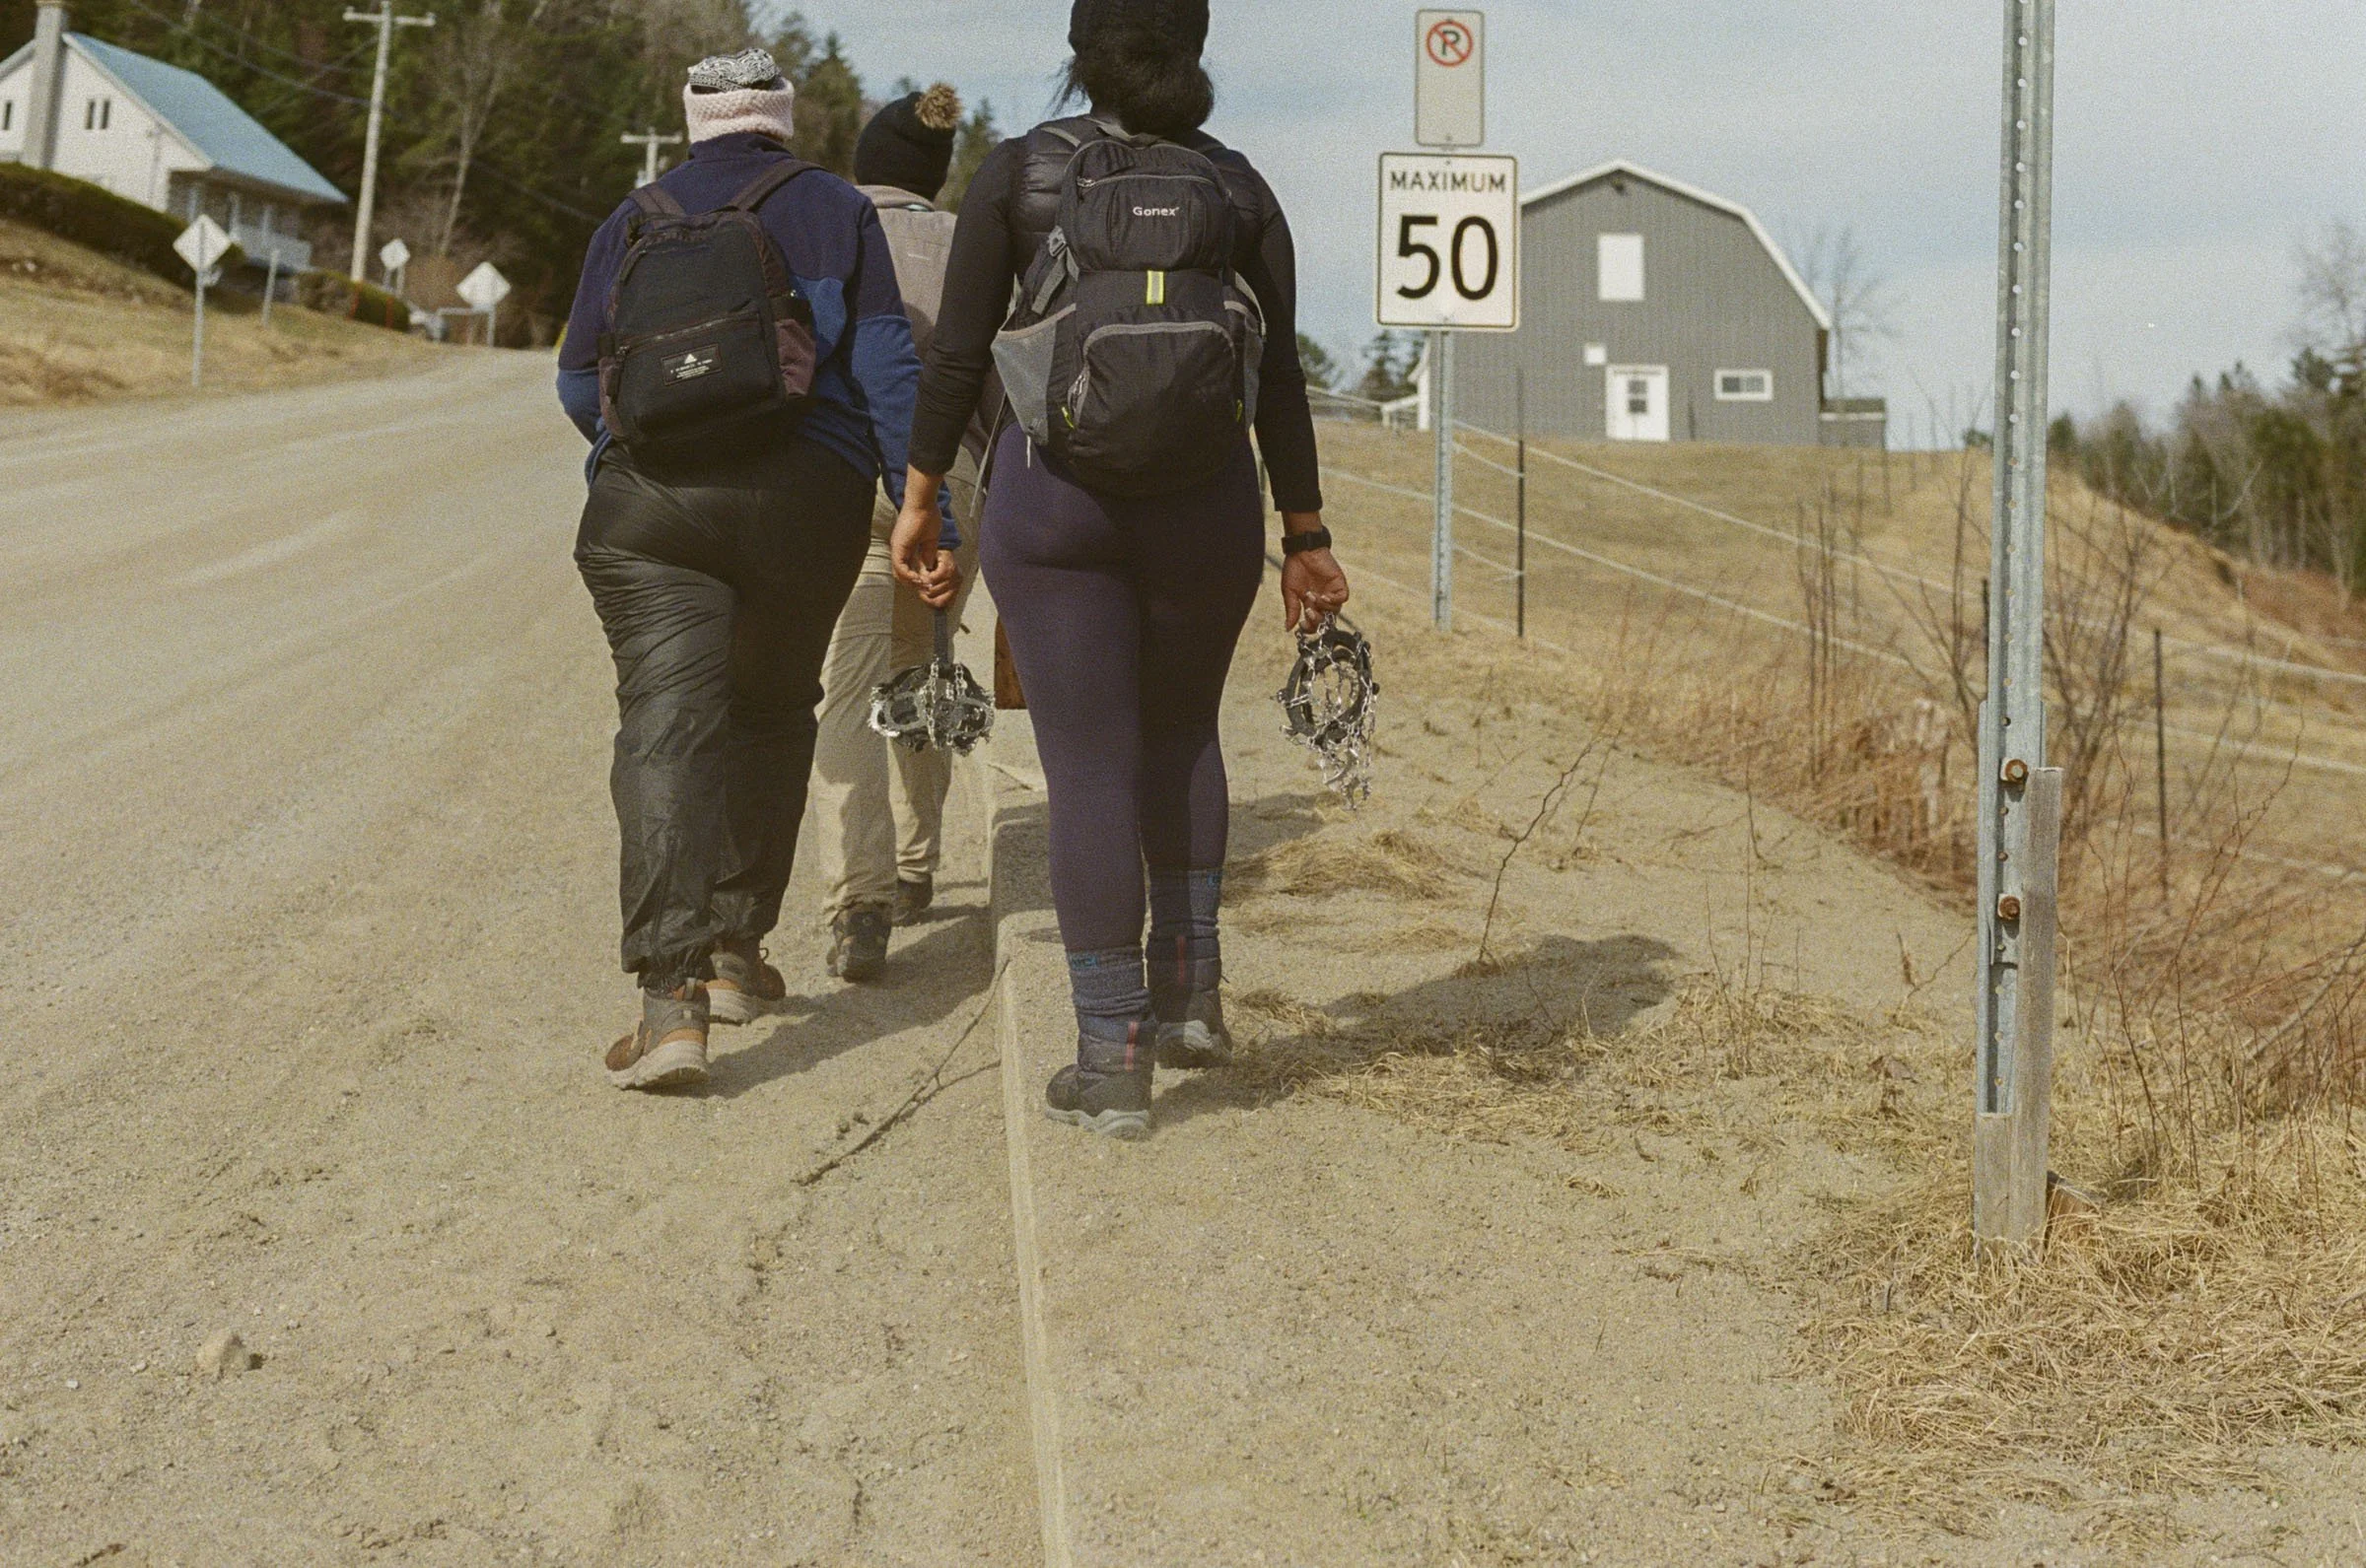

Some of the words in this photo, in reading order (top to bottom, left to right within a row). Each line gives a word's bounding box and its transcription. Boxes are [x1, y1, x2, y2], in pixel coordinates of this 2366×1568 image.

[1390, 170, 1506, 192] MAXIMUM
[1133, 206, 1176, 216] Gonex
[1397, 215, 1498, 301] 50
